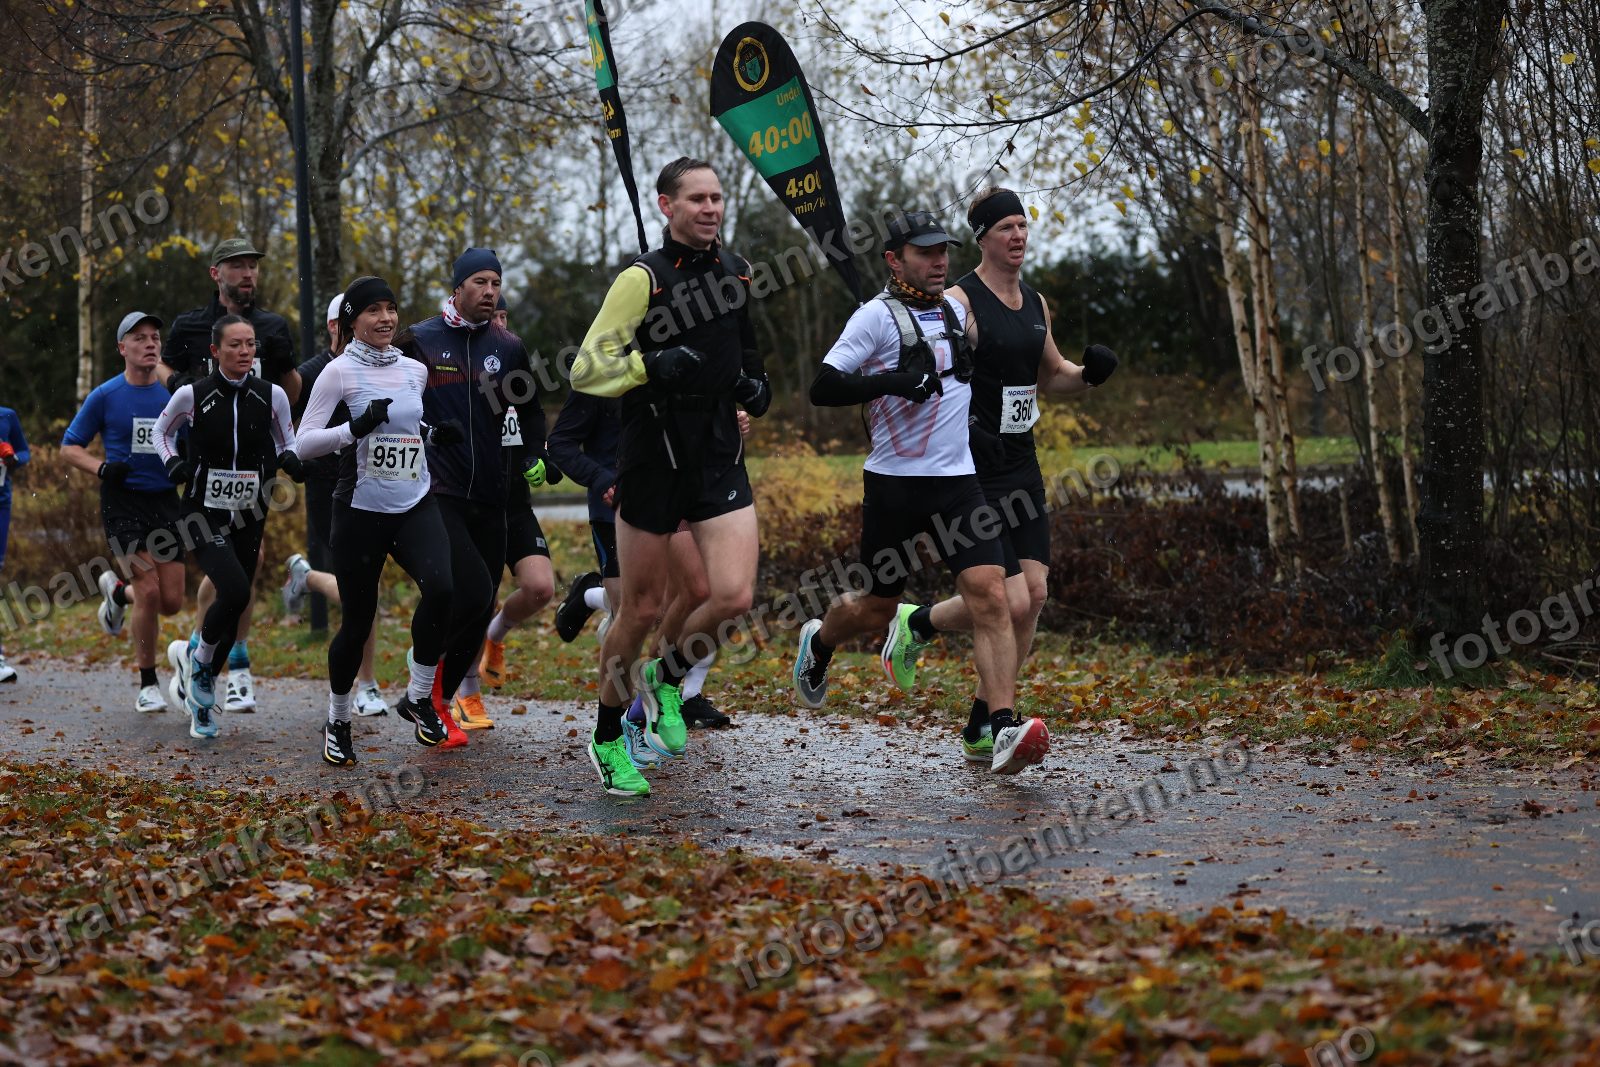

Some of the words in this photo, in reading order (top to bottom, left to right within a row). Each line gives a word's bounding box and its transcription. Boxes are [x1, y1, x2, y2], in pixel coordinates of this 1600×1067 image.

[749, 111, 812, 158] 40:00
[1011, 398, 1033, 422] 360
[375, 436, 421, 444] NORGESTESTEN
[373, 445, 420, 469] 9517
[211, 479, 255, 500] 9495
